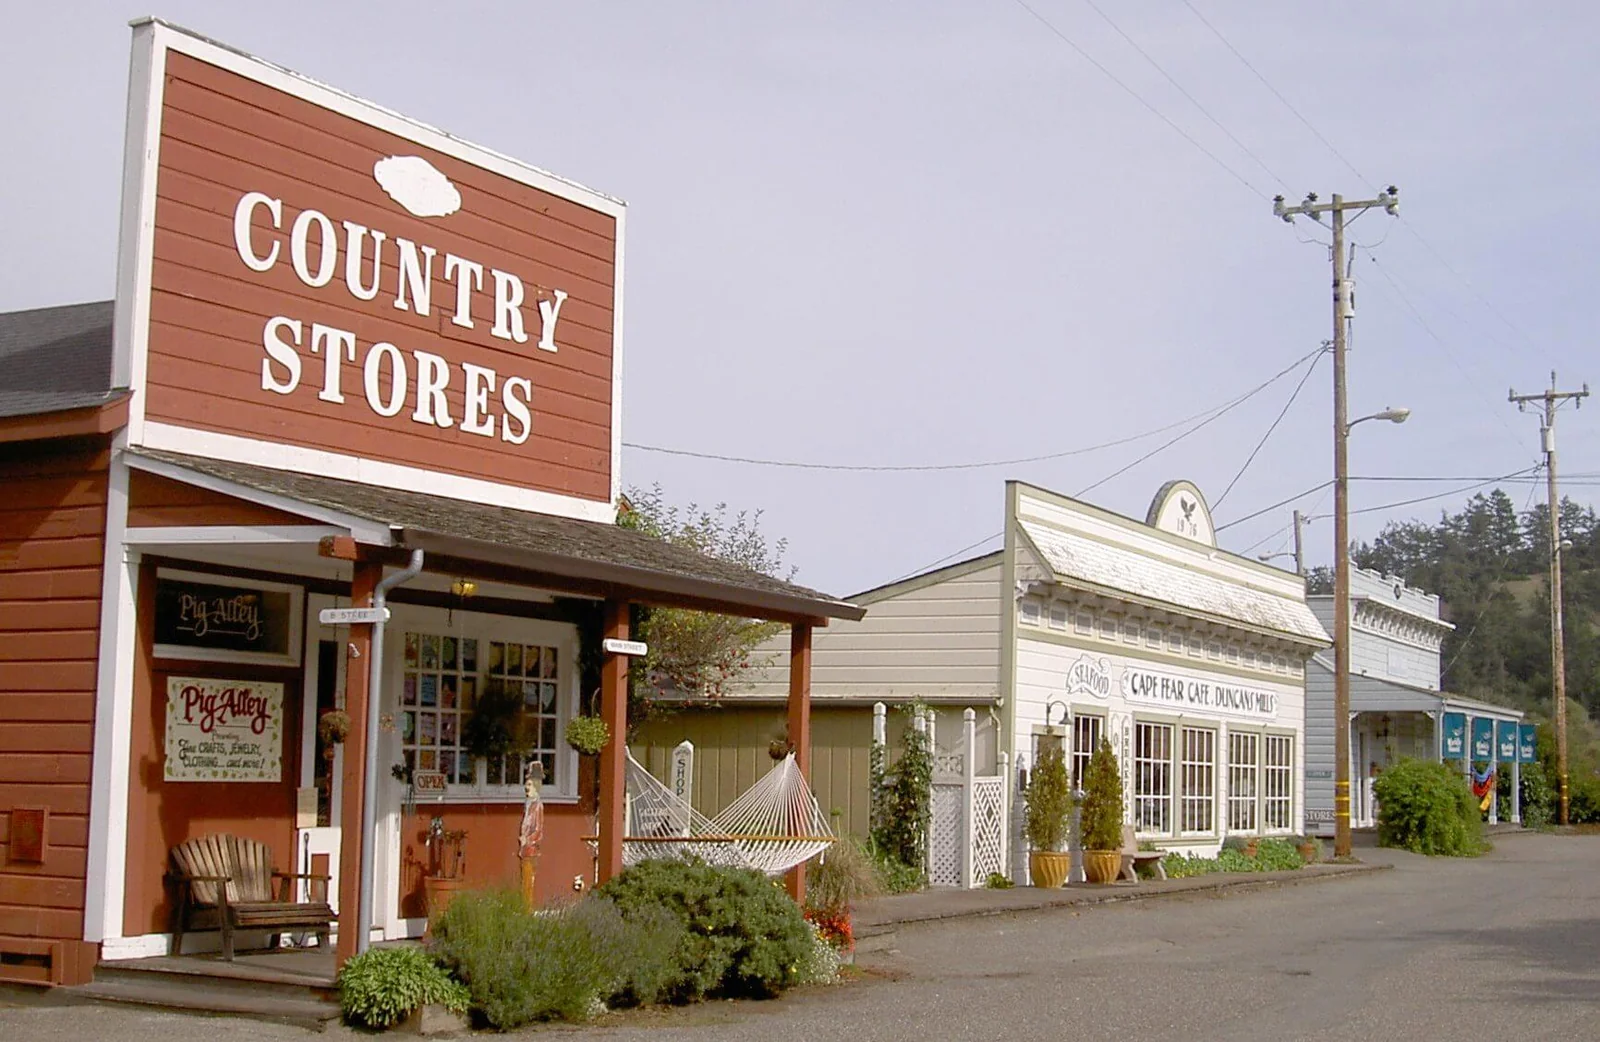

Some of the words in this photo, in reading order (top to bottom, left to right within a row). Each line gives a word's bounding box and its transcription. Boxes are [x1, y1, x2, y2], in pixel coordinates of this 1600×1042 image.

[234, 191, 568, 353] COUNTRY
[261, 316, 532, 445] STORES
[178, 593, 209, 637] Pig
[212, 594, 264, 641] Alley
[1074, 664, 1109, 694] SEAFOOD
[1131, 672, 1158, 698] CAPE
[1161, 677, 1184, 700] FEAR
[1215, 686, 1254, 711] DUNCANS
[1255, 691, 1274, 713] MILLS
[180, 685, 218, 734] Pig
[216, 687, 273, 735] Alley
[199, 742, 227, 755] CRAFTS,
[228, 743, 262, 757] JEWELRY,
[417, 775, 446, 790] OPEN
